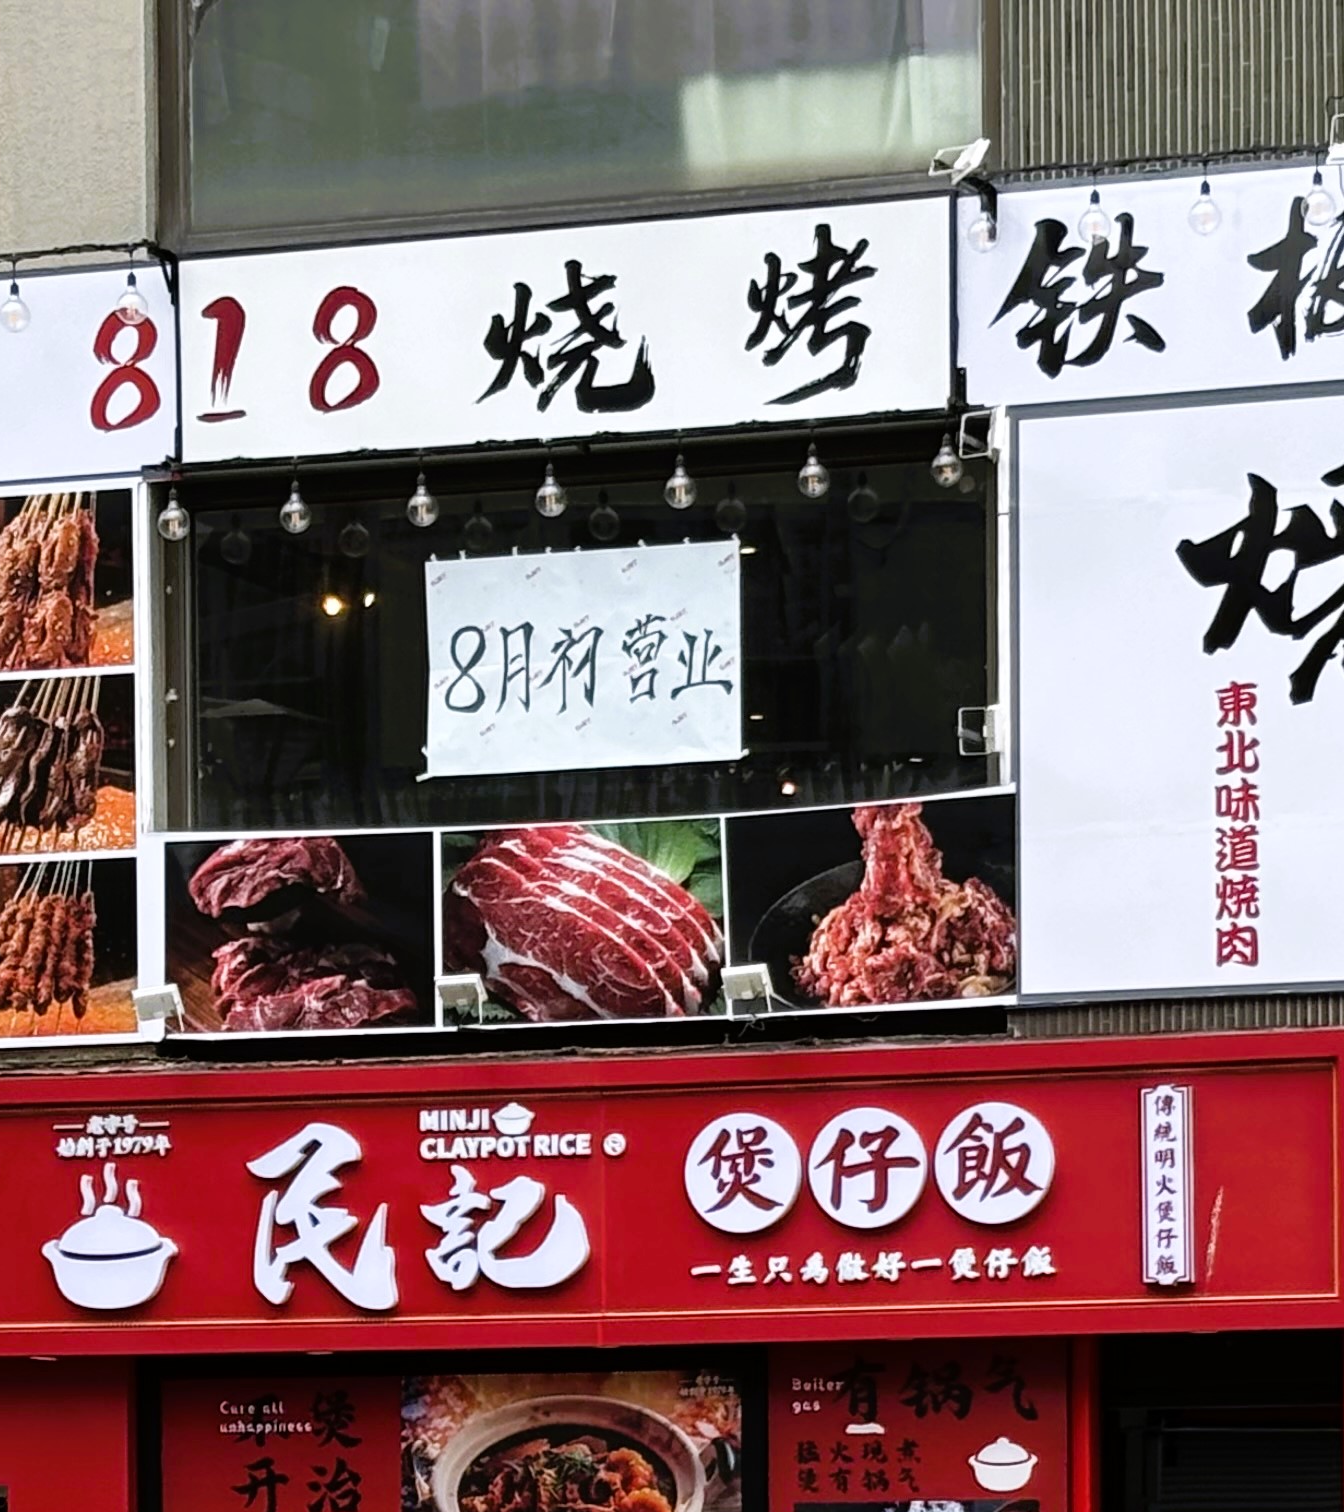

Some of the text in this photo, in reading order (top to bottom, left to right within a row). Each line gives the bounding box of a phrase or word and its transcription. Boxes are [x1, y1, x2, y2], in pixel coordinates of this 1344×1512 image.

[473, 224, 879, 413] 烧烤
[91, 286, 380, 432] 818
[419, 1108, 490, 1131] MINJI
[420, 1134, 592, 1159] CLAYPOT RICE
[697, 1111, 1045, 1214] 煲仔飯
[262, 1401, 285, 1415] all
